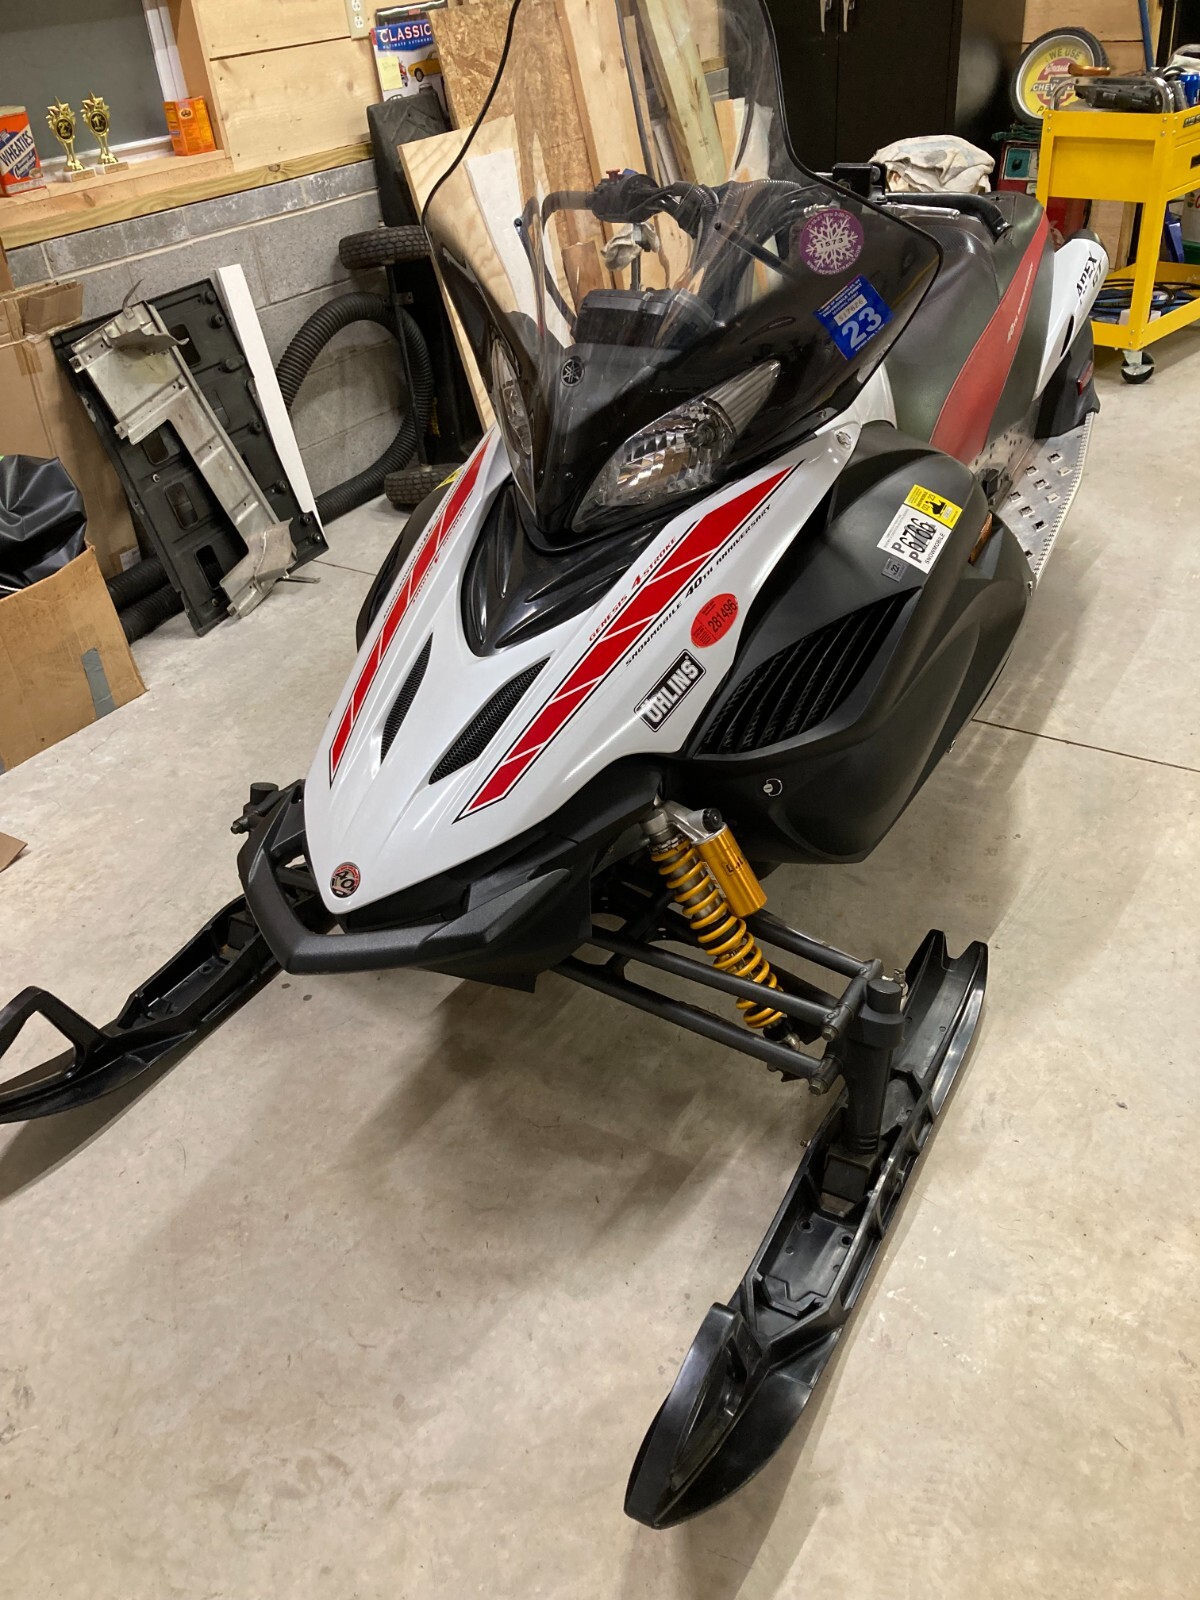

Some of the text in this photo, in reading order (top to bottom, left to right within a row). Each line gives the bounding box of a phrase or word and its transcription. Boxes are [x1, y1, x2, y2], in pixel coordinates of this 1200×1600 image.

[380, 23, 432, 43] CLASSIC
[1049, 48, 1081, 60] WE USE
[0, 130, 34, 167] WHEATIES
[820, 237, 844, 249] 1573
[841, 306, 882, 349] 23
[891, 541, 906, 554] P
[899, 517, 937, 554] 6766
[924, 532, 946, 564] SNOWMOBILE
[908, 551, 923, 563] P
[625, 503, 771, 667] SNOWMOBILE 40TH ANNIVERSARY
[588, 594, 628, 642] GENESIS
[707, 598, 738, 634] 281496
